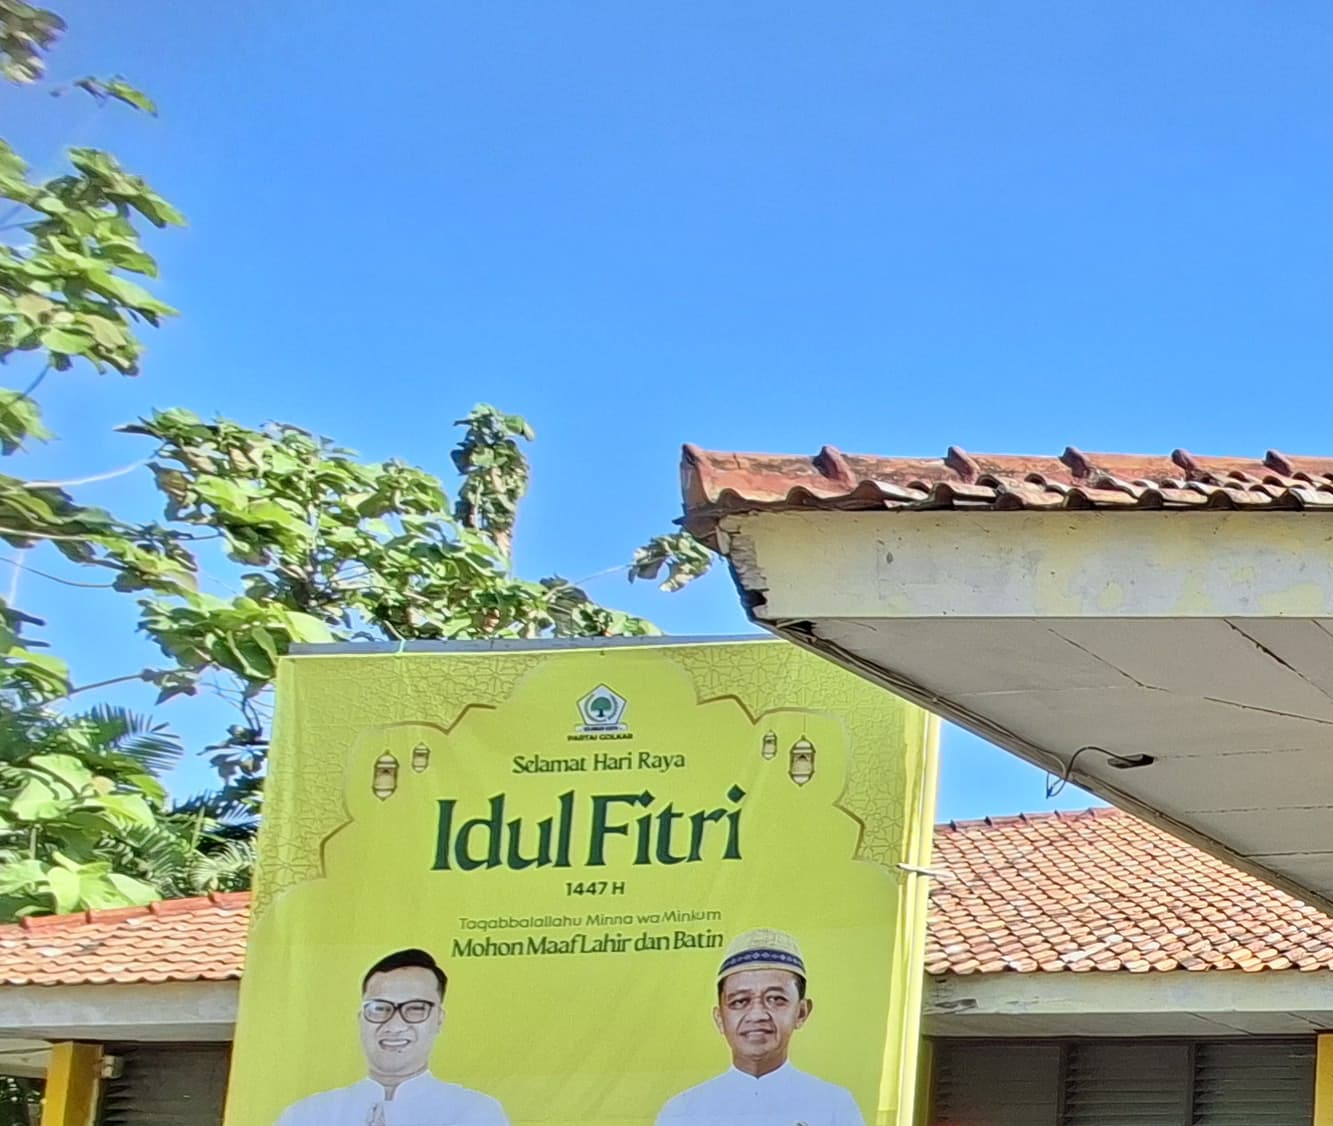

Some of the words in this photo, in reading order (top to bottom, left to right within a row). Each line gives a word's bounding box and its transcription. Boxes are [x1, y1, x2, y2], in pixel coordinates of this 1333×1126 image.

[512, 754, 587, 774] Selamat
[593, 751, 633, 771] Hari
[638, 751, 685, 773] Raya
[430, 790, 575, 871] Idul
[584, 783, 747, 867] Fitri
[566, 881, 608, 896] 1447
[612, 880, 625, 895] H
[586, 913, 633, 927] Minna
[636, 914, 660, 925] wa
[661, 909, 722, 922] Minkum
[451, 936, 524, 958] Mohon
[525, 933, 583, 956] Maaf
[580, 933, 633, 954] Lahir
[634, 931, 670, 952] dan
[672, 928, 724, 950] Batin
